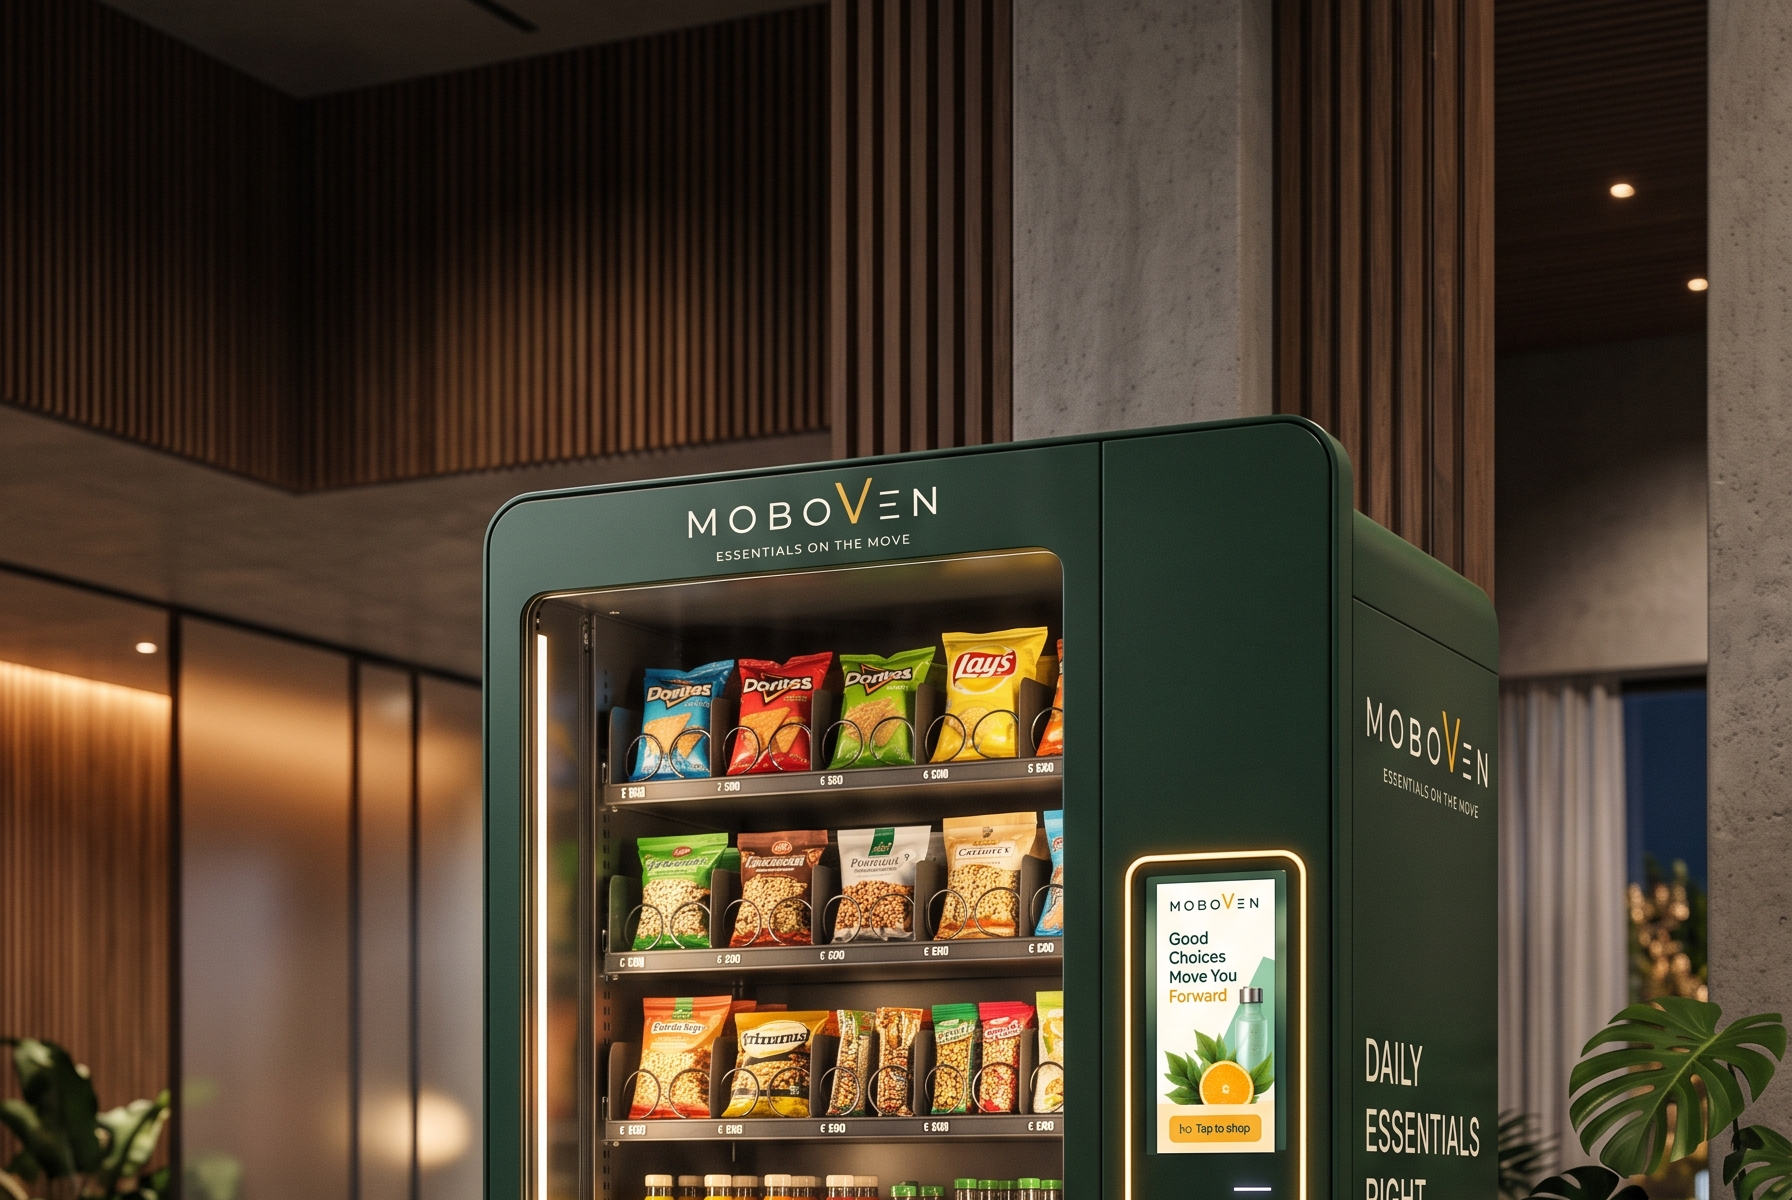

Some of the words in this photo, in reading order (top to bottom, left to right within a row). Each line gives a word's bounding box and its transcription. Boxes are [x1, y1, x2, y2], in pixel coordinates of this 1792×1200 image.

[688, 477, 937, 539] MOBOVEN
[716, 543, 802, 562] ESSENTIALS
[807, 541, 829, 553] ON
[834, 538, 862, 551] THE
[867, 533, 911, 548] MOVE
[1366, 696, 1488, 788] MOBOVEN
[1383, 767, 1429, 799] ESSENTIALS
[1430, 787, 1442, 804] ON
[1443, 792, 1457, 810] THE
[1169, 892, 1259, 912] MOBOVEN
[1168, 930, 1209, 946] Good
[1168, 949, 1227, 965] Choices
[1169, 969, 1208, 984] Move
[1210, 968, 1237, 983] You
[1169, 987, 1228, 1004] Forward
[1365, 1037, 1423, 1087] DAILY
[1195, 1123, 1213, 1135] Tap
[1214, 1123, 1225, 1134] to
[1226, 1123, 1251, 1135] shop
[1365, 1107, 1480, 1157] ESSENTIALS
